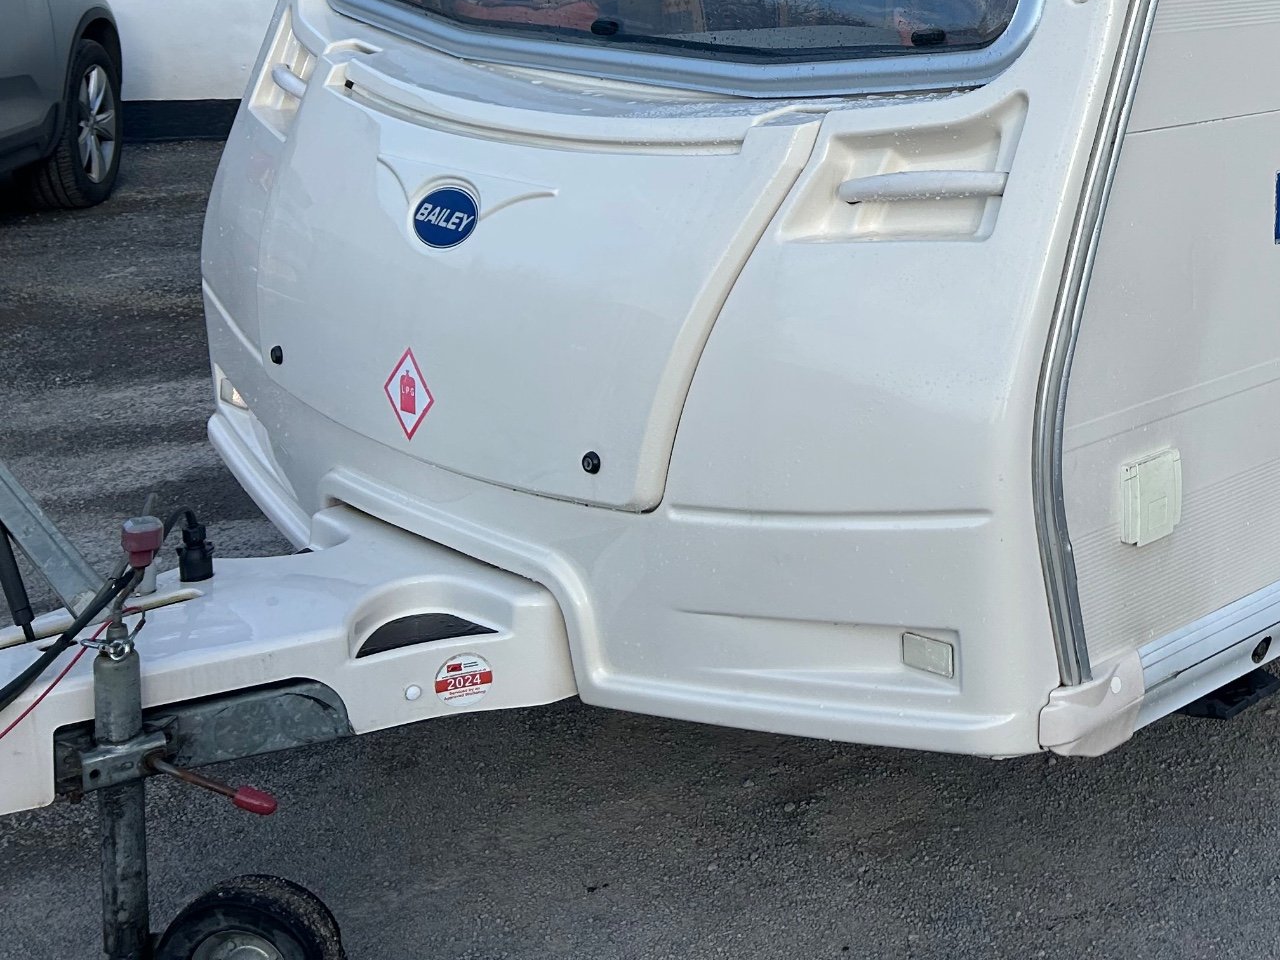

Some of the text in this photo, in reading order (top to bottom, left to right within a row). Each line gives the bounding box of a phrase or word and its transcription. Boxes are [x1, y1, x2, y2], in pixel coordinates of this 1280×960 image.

[415, 202, 475, 232] BAILEY
[401, 384, 415, 397] LPG
[447, 674, 481, 690] 2024
